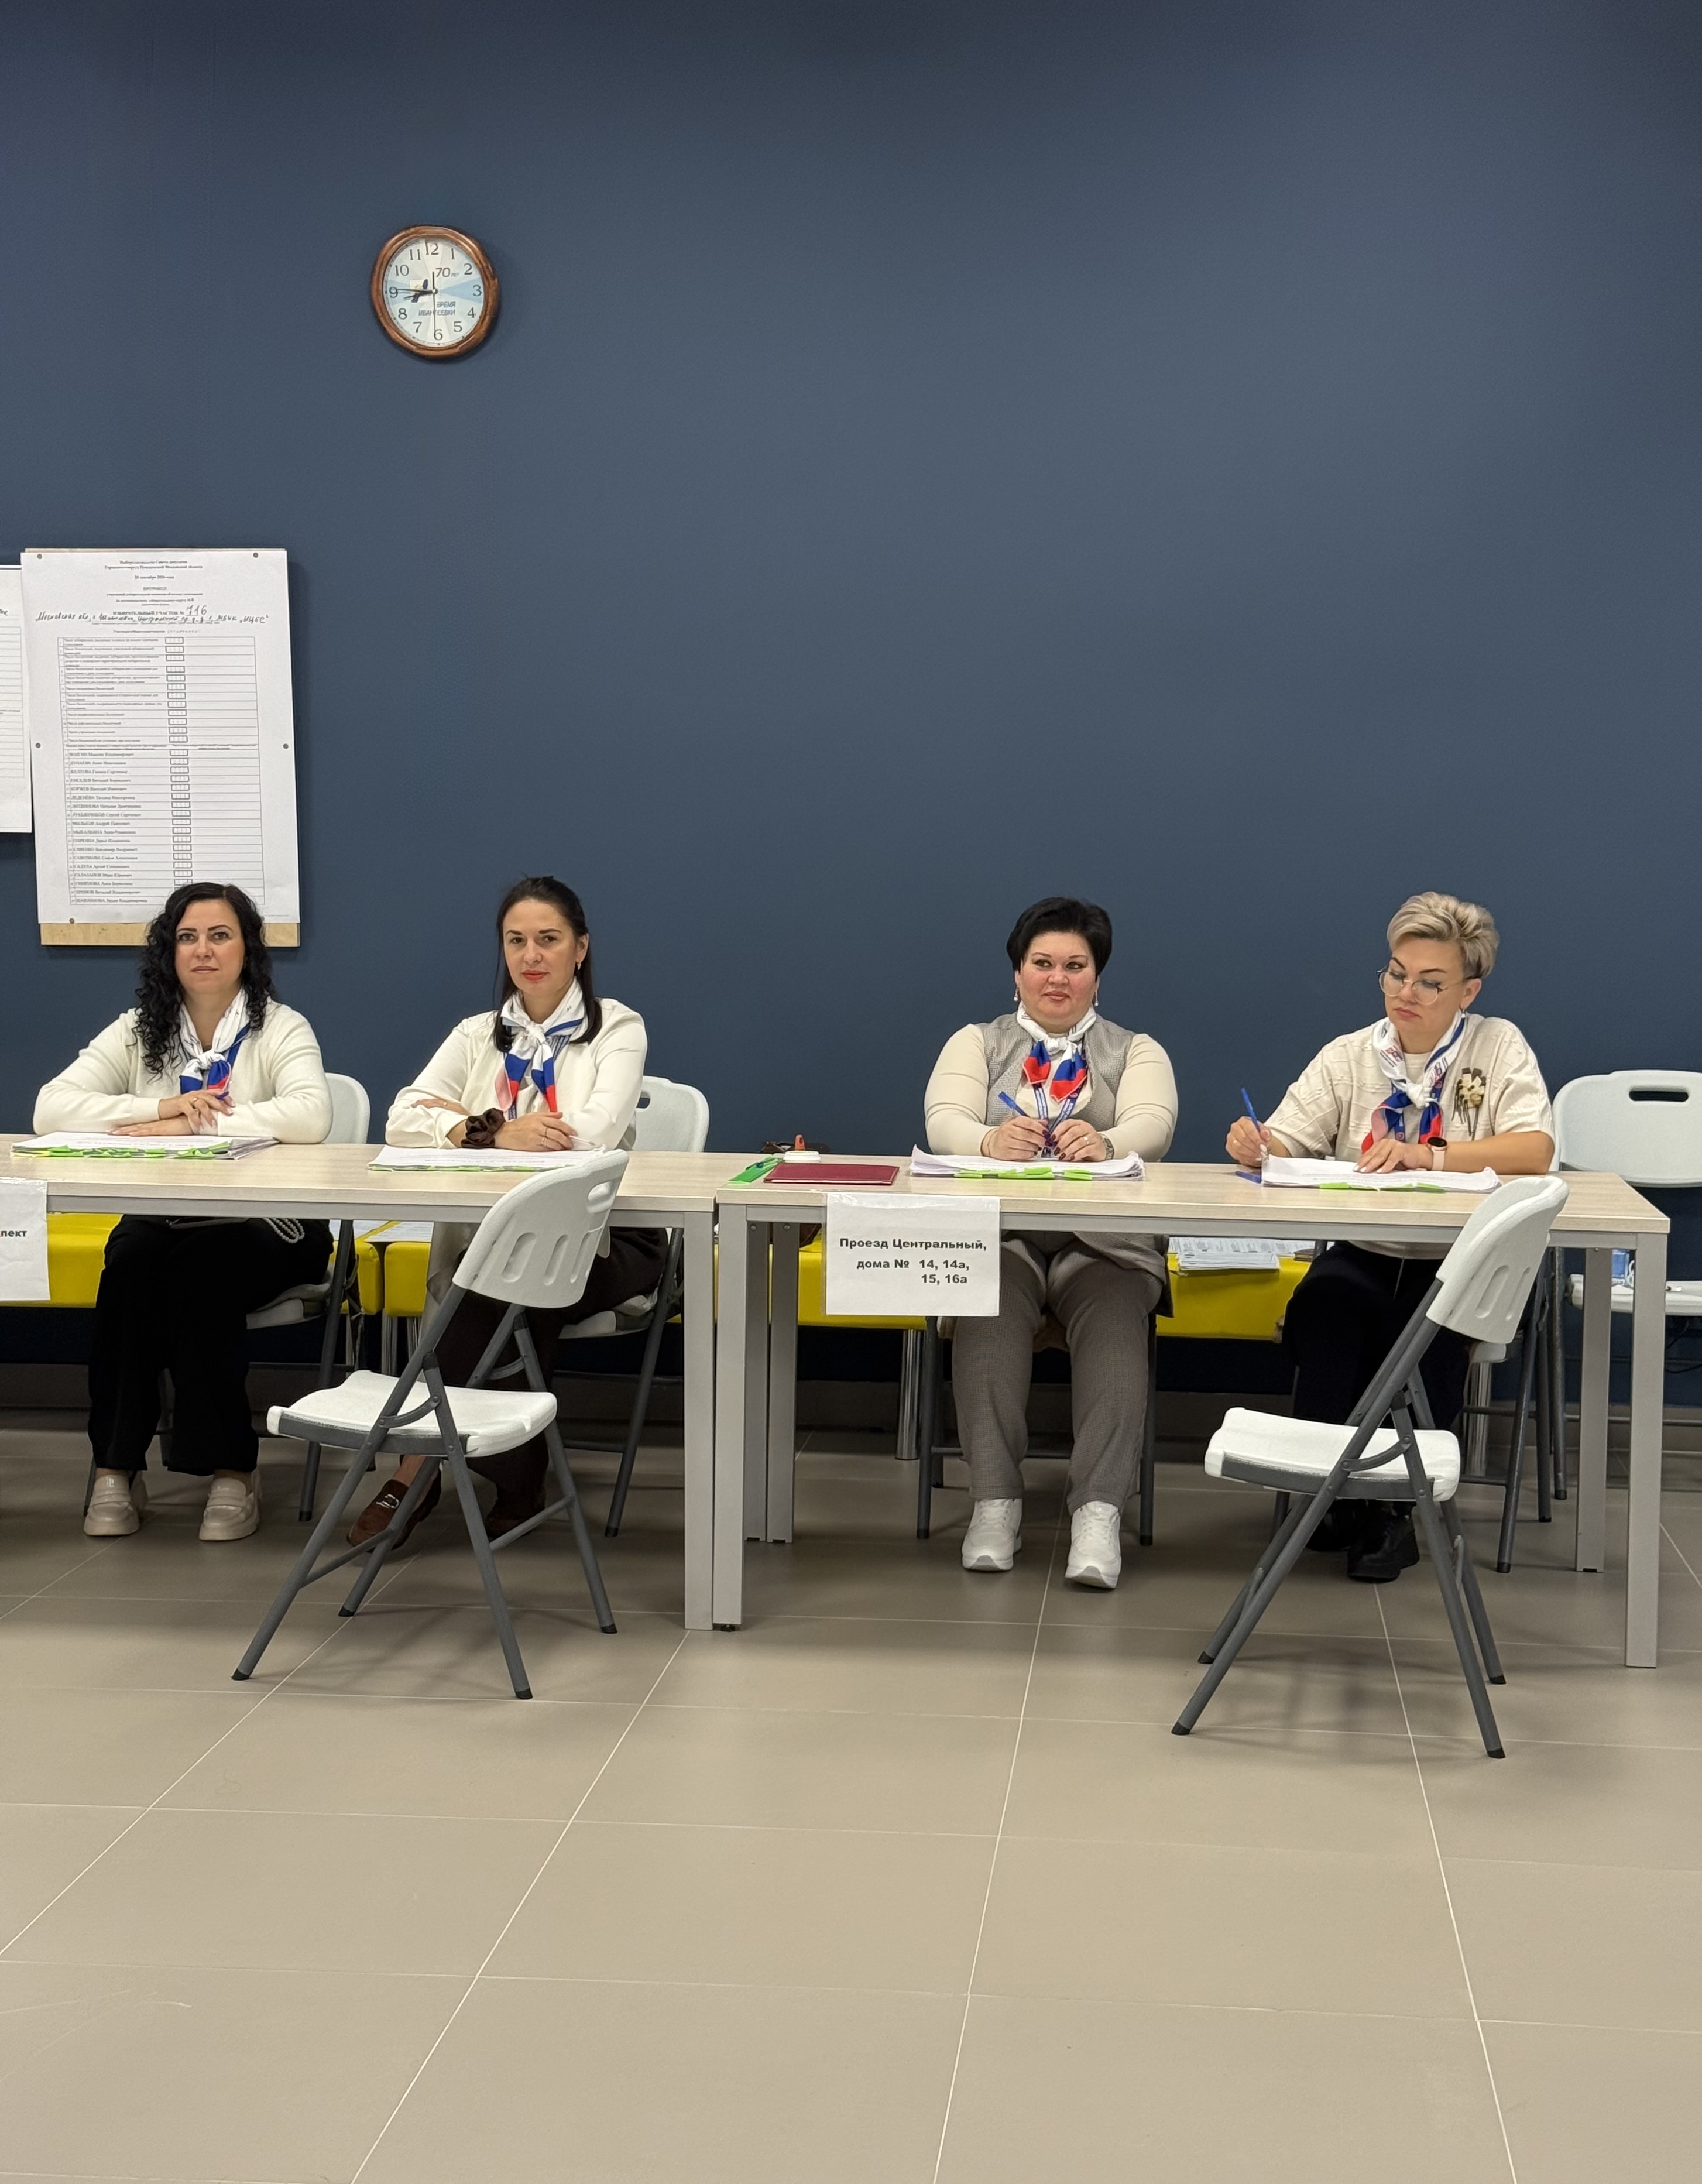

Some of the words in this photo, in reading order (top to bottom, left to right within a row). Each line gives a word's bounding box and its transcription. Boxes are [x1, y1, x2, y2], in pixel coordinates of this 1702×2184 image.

[410, 249, 421, 261] 11
[425, 242, 439, 256] 12
[450, 248, 455, 260] 1
[395, 264, 409, 277] 10
[435, 267, 451, 278] 70
[464, 263, 473, 275] 2
[389, 286, 399, 299] 9
[472, 284, 482, 297] 3
[397, 308, 408, 320] 8
[467, 307, 476, 319] 4
[413, 321, 423, 334] 7
[453, 321, 463, 333] 5
[434, 328, 444, 341] 6
[840, 1237, 888, 1250] Проезд
[893, 1239, 987, 1252] Центральный,
[856, 1261, 890, 1270] дома
[894, 1259, 910, 1268] №
[919, 1259, 938, 1271] 14,
[942, 1259, 970, 1271] 14а,
[921, 1274, 940, 1285] 15,
[945, 1274, 967, 1284] 16а
